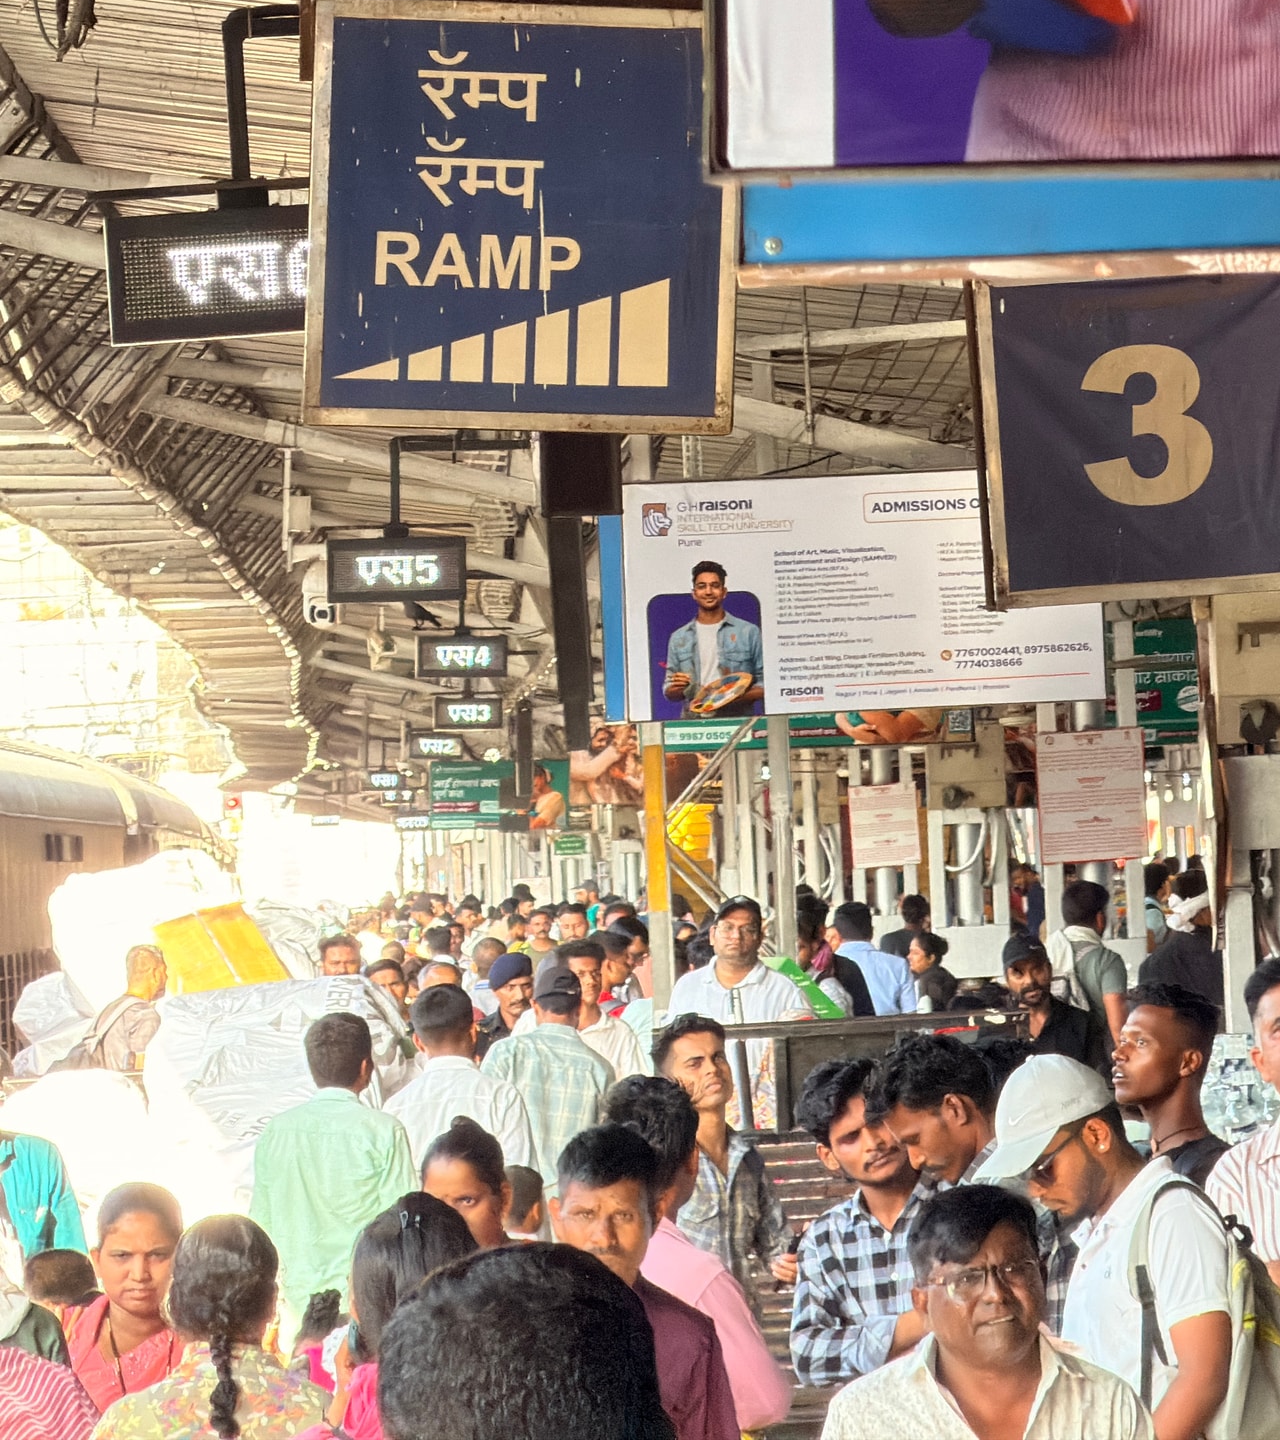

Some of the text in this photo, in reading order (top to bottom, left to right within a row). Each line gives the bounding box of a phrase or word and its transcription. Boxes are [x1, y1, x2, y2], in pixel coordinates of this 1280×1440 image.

[374, 230, 583, 291] RAMP
[1080, 344, 1213, 506] 3
[871, 498, 966, 513] ADMISSIONS
[677, 512, 756, 523] INTERNATIONAL
[708, 522, 735, 532] TECH
[736, 520, 794, 530] UNIVERSITY
[678, 539, 703, 547] Pune
[355, 554, 440, 586] एस5
[435, 644, 492, 669] एस4
[955, 658, 1023, 669] 7774038666
[780, 686, 824, 696] raisoni
